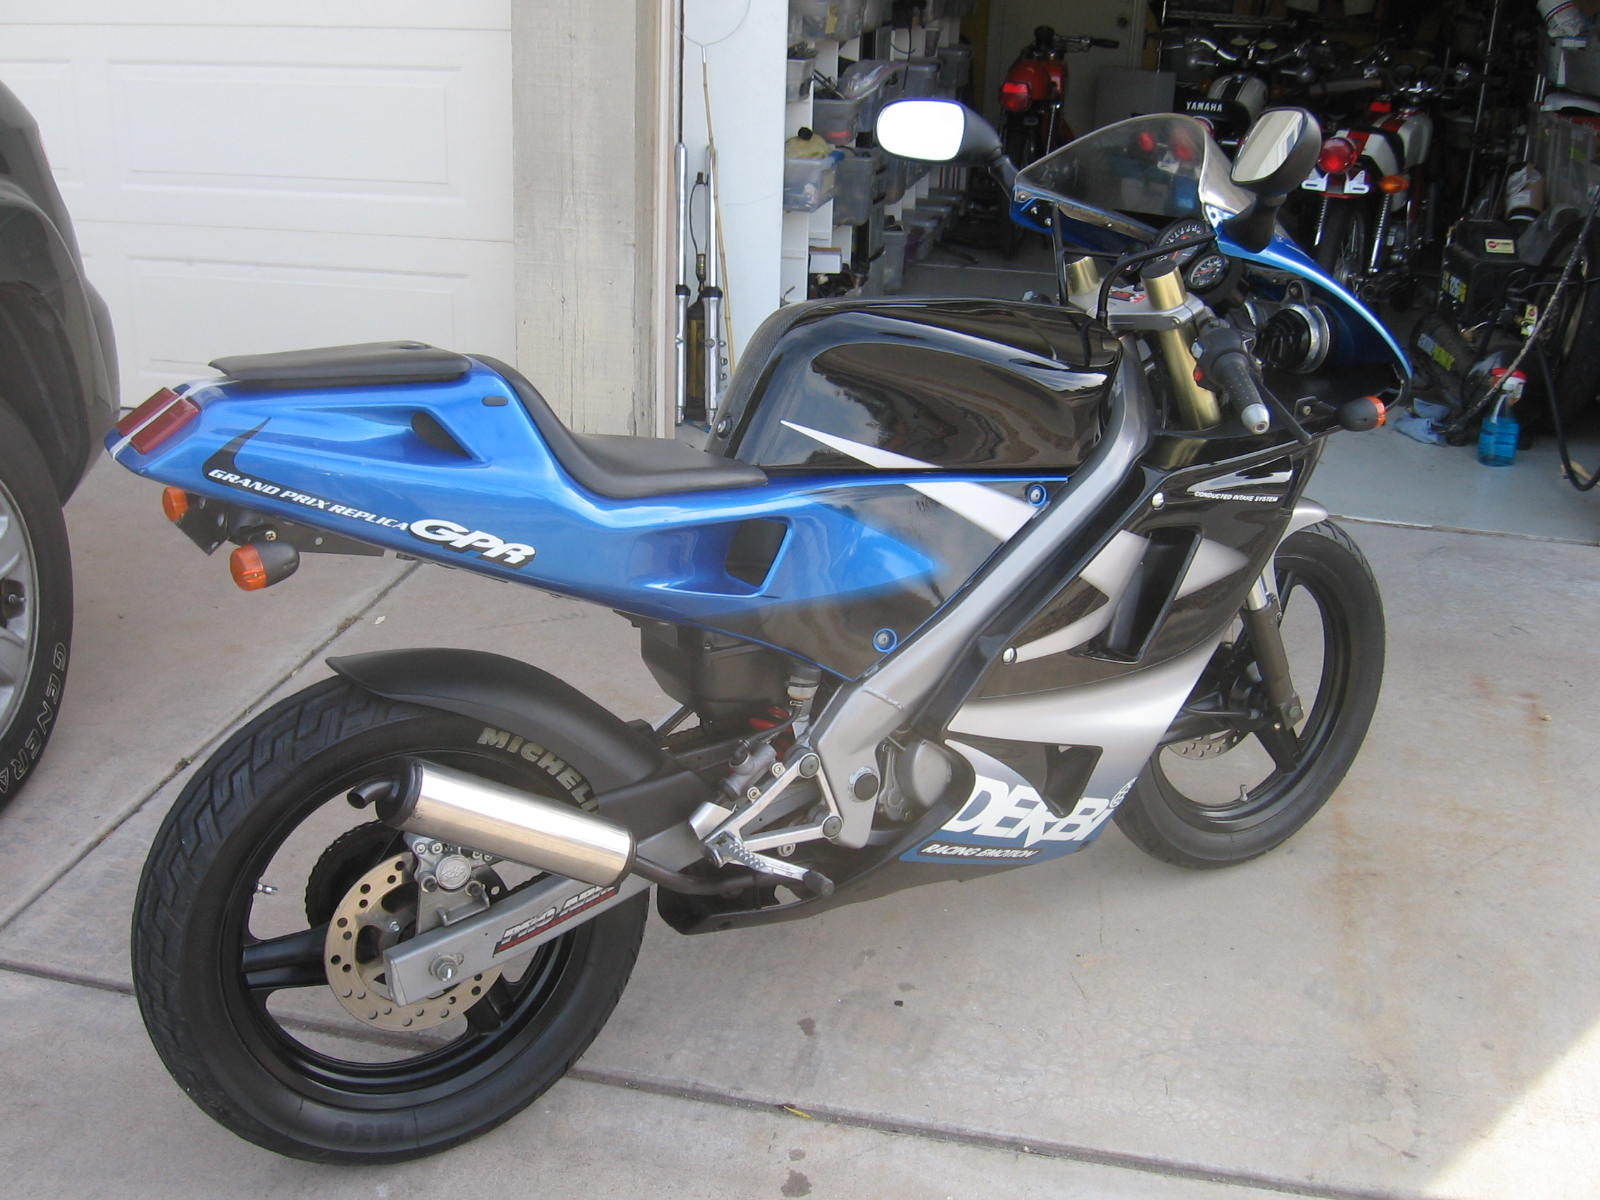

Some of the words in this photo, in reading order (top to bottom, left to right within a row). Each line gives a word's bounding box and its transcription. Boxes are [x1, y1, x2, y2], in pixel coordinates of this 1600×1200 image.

[1186, 101, 1223, 112] YAMAHA
[208, 468, 281, 495] GRAND
[280, 490, 330, 510] PRIX
[327, 504, 409, 531] REPLICA
[410, 519, 537, 566] GPR
[940, 774, 1114, 849] DERBI
[920, 843, 981, 857] RACING
[975, 848, 1039, 859] EMOTION
